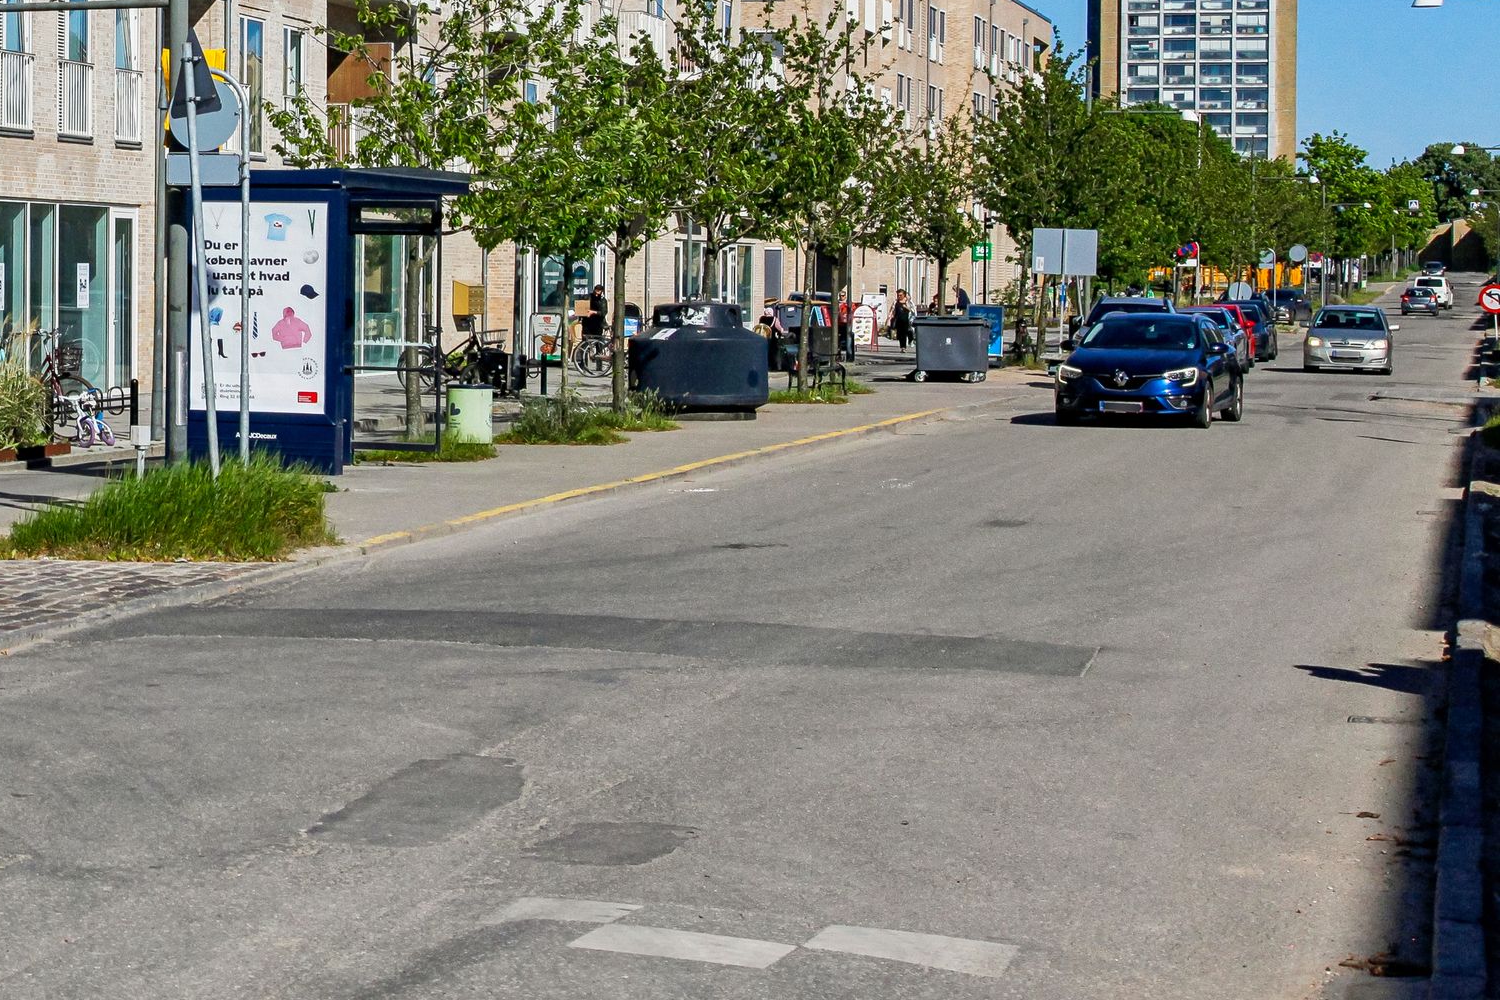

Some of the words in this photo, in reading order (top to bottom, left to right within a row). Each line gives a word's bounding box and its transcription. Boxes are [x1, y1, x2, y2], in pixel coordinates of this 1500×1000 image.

[204, 240, 220, 250] Du
[224, 242, 239, 250] er
[205, 255, 288, 266] købenavner
[212, 271, 256, 281] uanst
[259, 271, 290, 281] hvad
[248, 285, 264, 298] på
